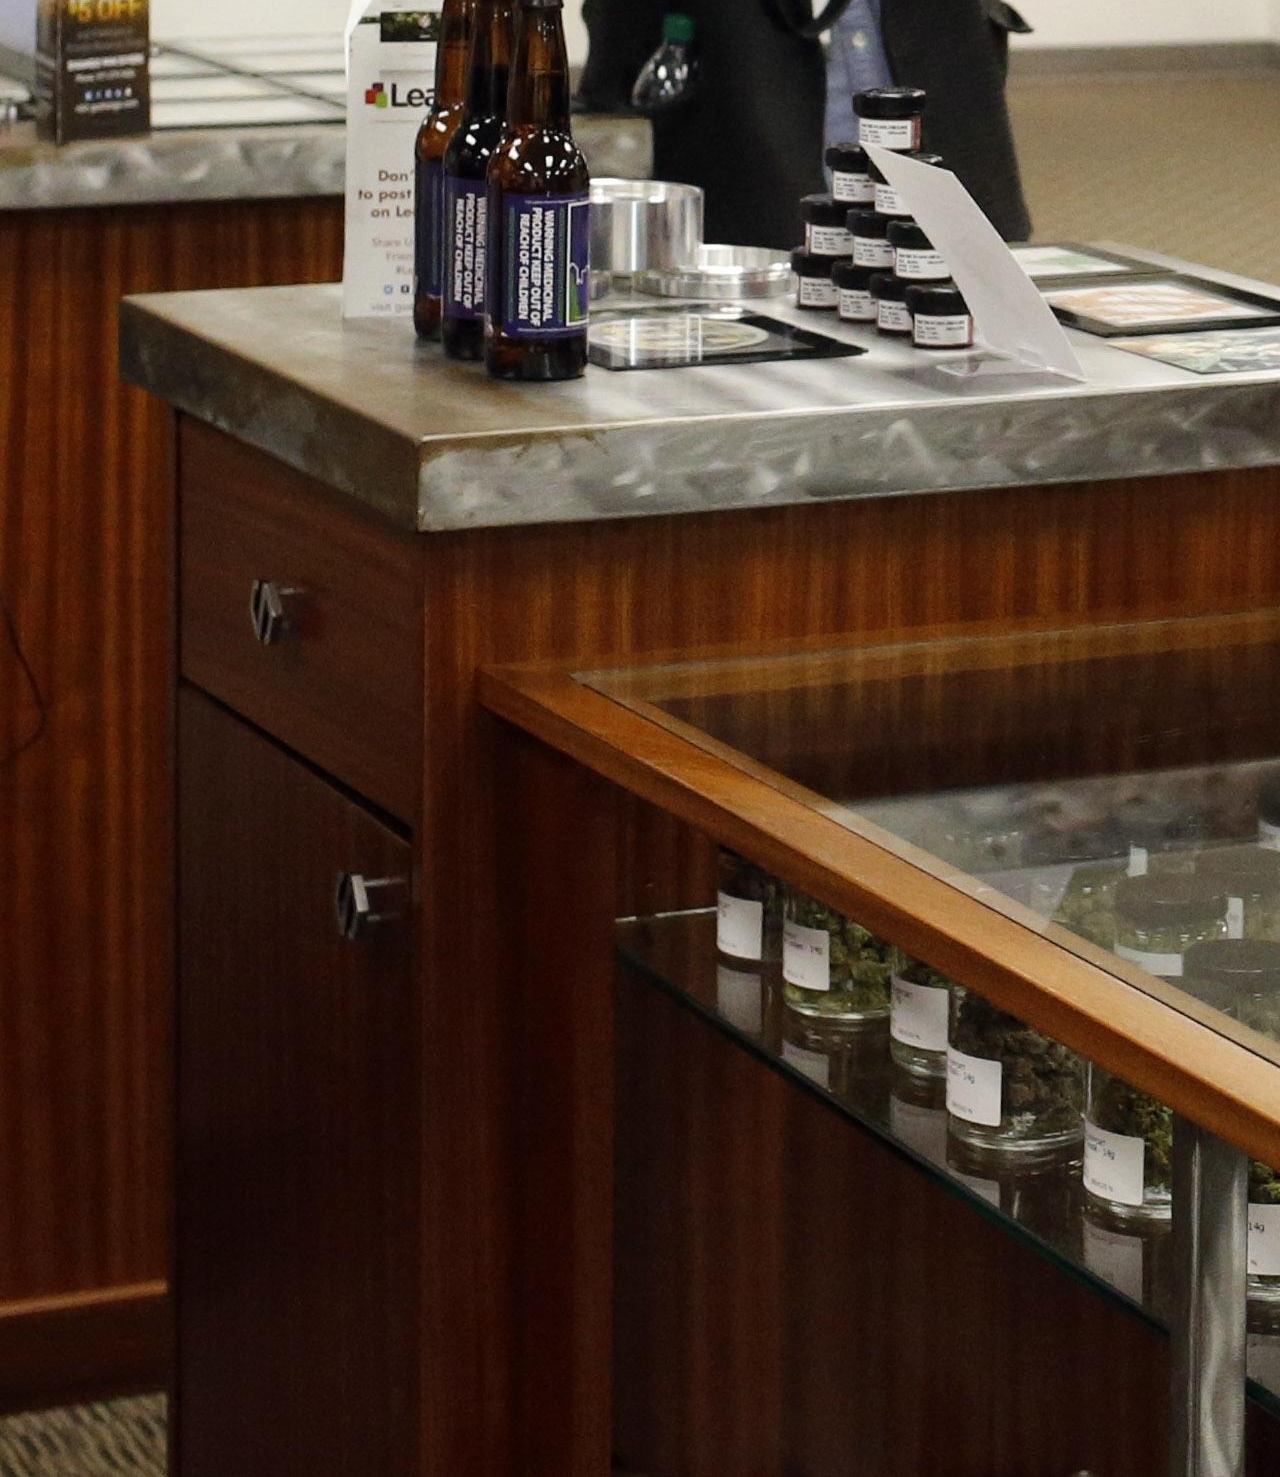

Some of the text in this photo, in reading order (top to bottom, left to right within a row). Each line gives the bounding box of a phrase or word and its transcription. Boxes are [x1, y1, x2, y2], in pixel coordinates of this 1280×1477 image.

[358, 190, 412, 201] to post
[371, 209, 390, 218] on
[455, 198, 464, 233] REACH
[455, 234, 464, 249] OF
[463, 193, 476, 309] PRODUCT KEEP OUT OF
[518, 213, 530, 320] REACH OF CHILDREN
[530, 207, 543, 326] PRODUCT KEEP OUT OF
[543, 210, 555, 321] WARNING MEDICINAL
